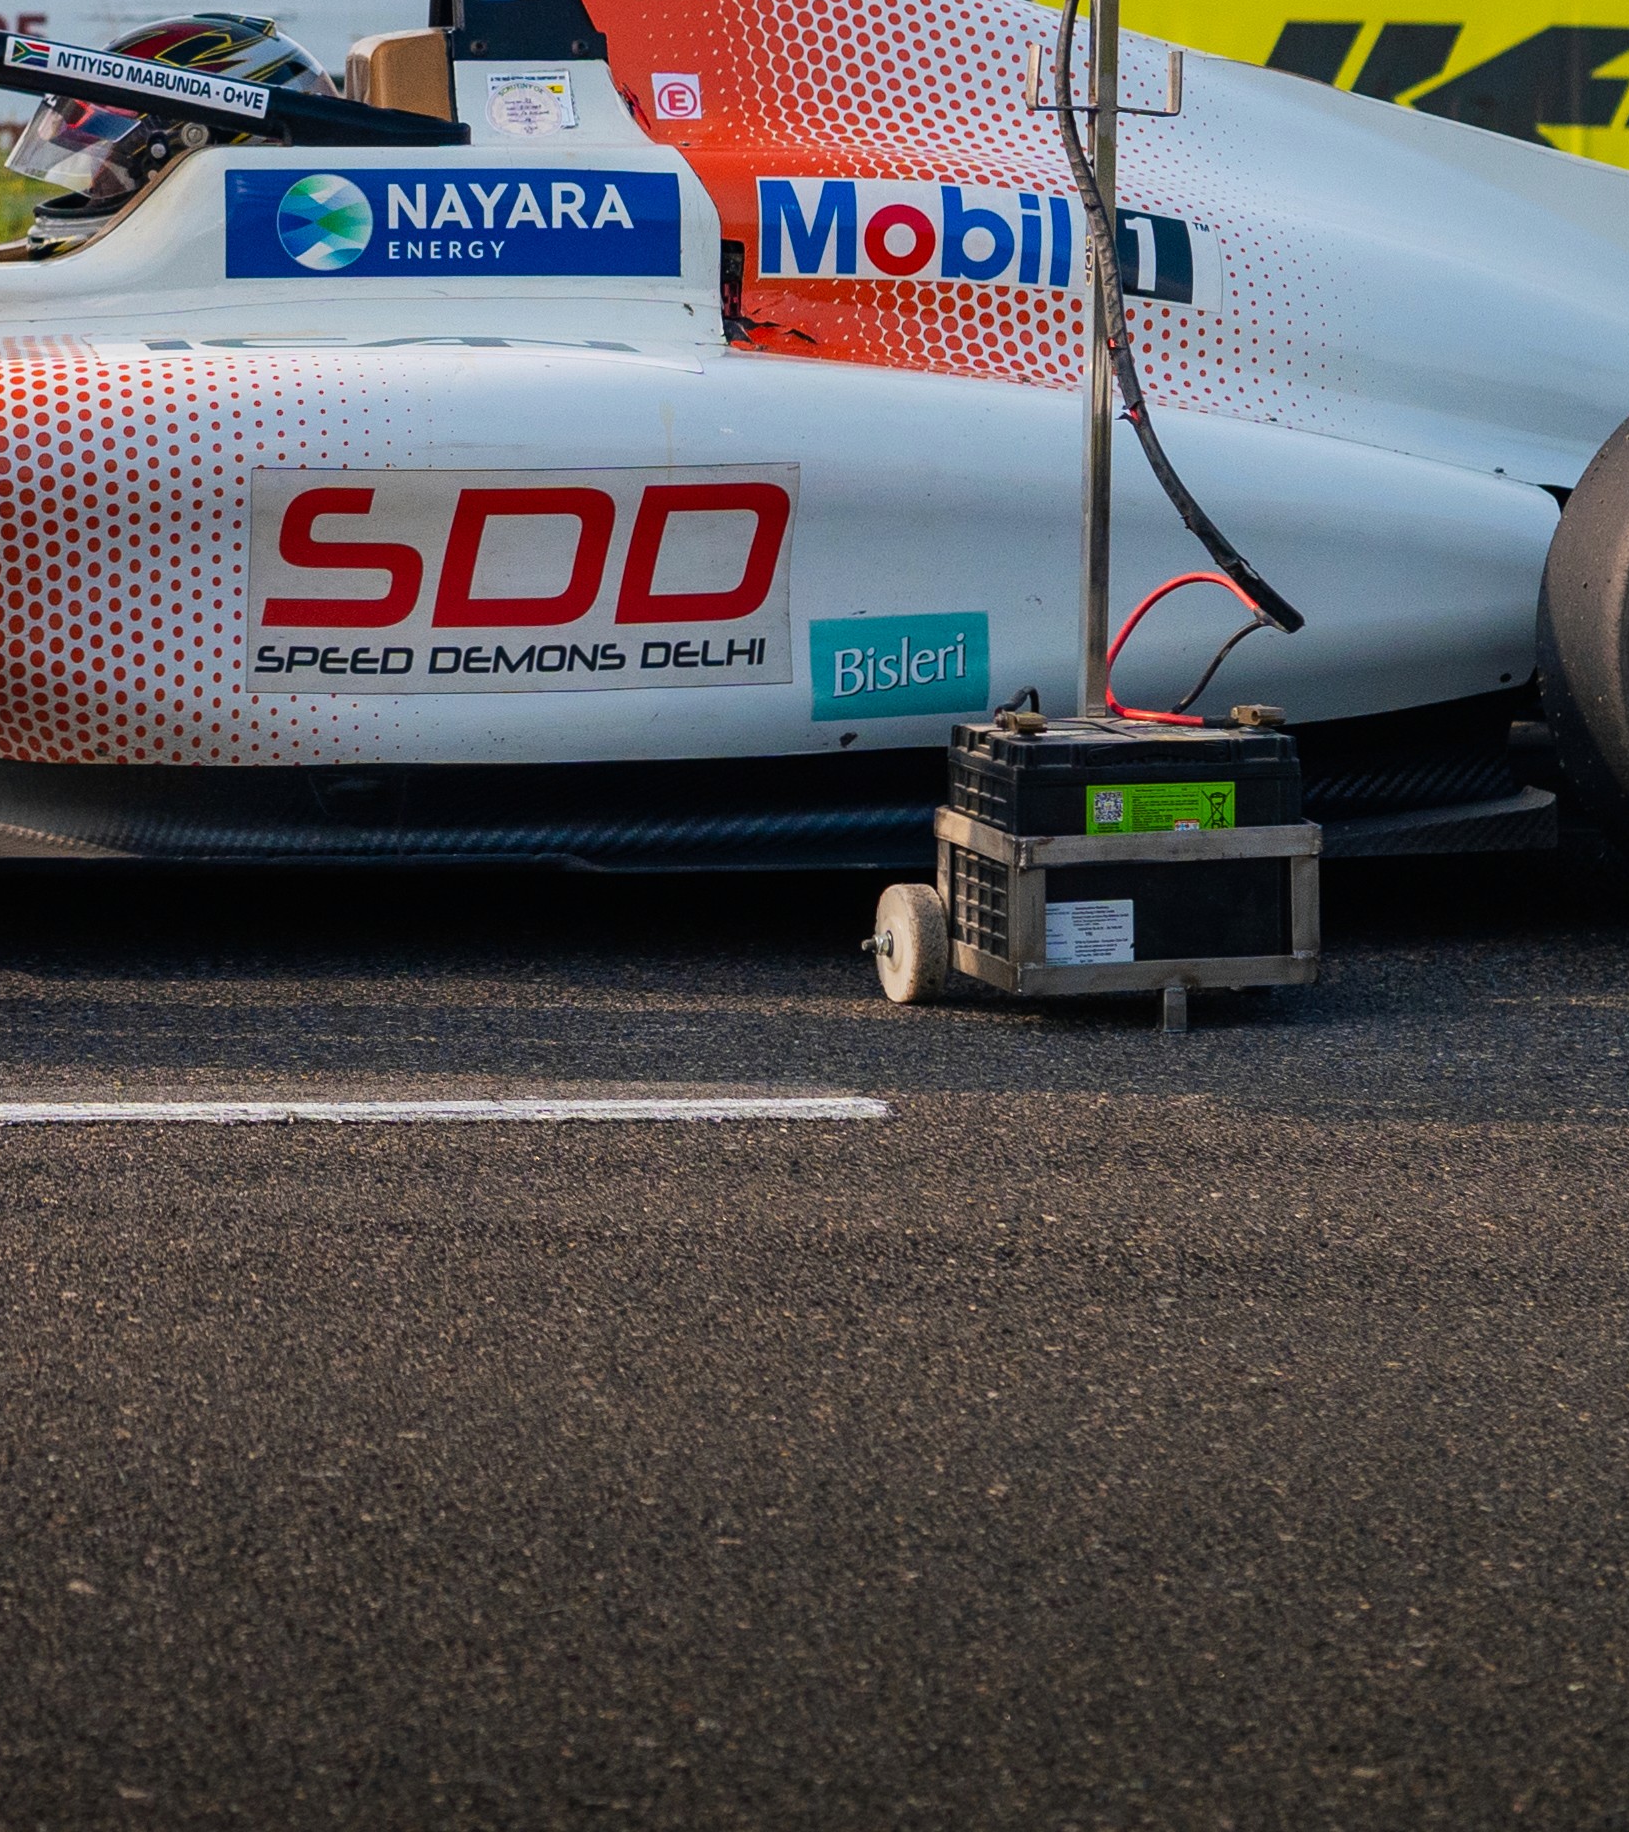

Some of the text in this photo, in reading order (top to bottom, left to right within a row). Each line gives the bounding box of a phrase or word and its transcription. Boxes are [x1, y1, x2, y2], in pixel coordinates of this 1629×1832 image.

[57, 50, 125, 82] NTIYISO
[126, 57, 214, 99] MABUNDA
[387, 182, 635, 230] NAYARA
[388, 239, 506, 260] ENERGY
[759, 178, 1072, 287] Mobil
[1124, 216, 1156, 291] 1
[261, 482, 792, 629] SDD
[253, 635, 766, 677] SPEED DEMONS DELHI
[833, 632, 967, 700] Bisleri
